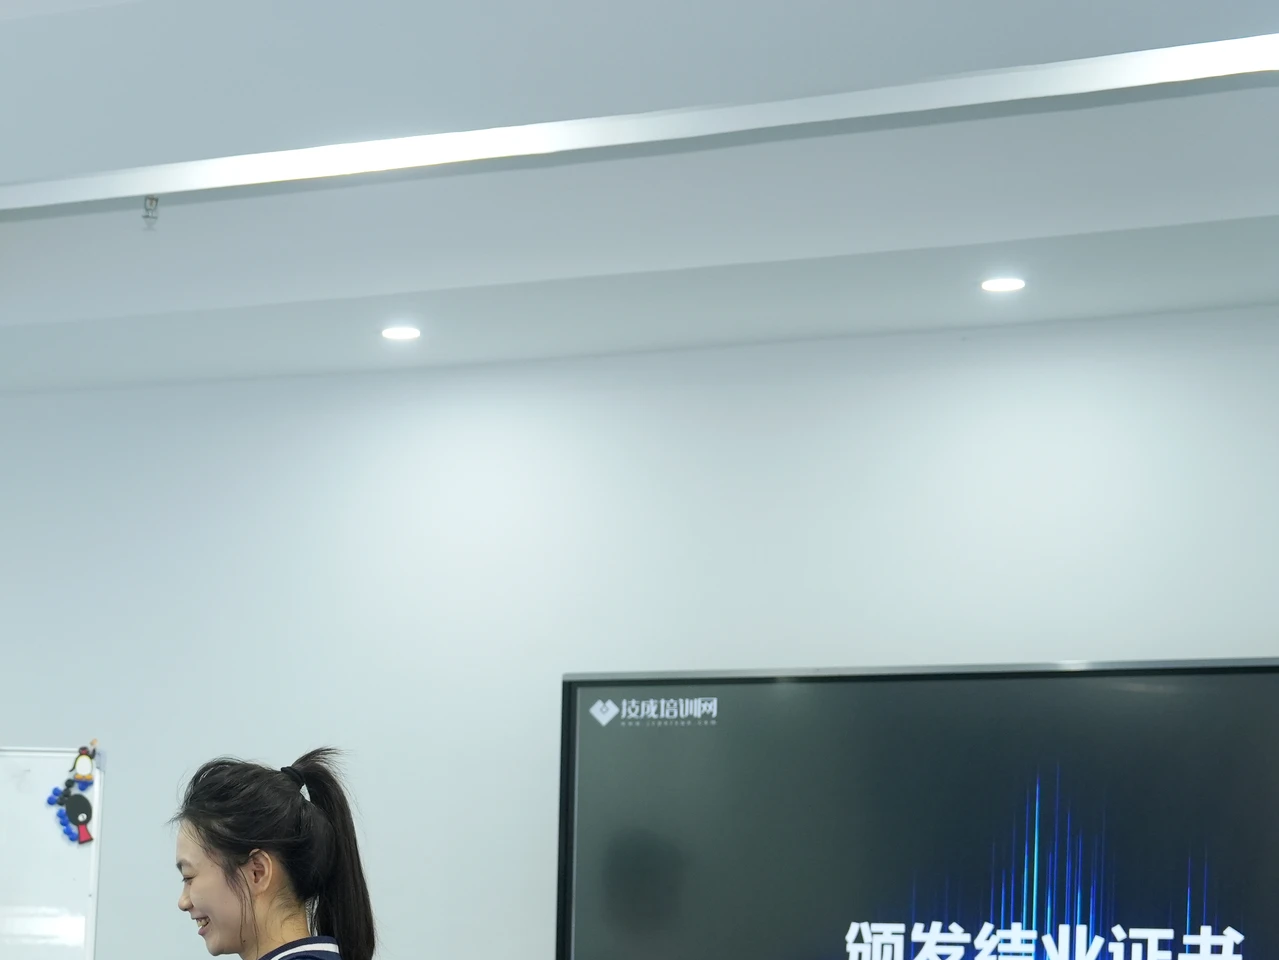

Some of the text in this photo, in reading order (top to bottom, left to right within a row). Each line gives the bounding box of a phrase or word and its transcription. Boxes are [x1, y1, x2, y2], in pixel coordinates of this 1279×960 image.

[621, 697, 718, 720] 技成培训网
